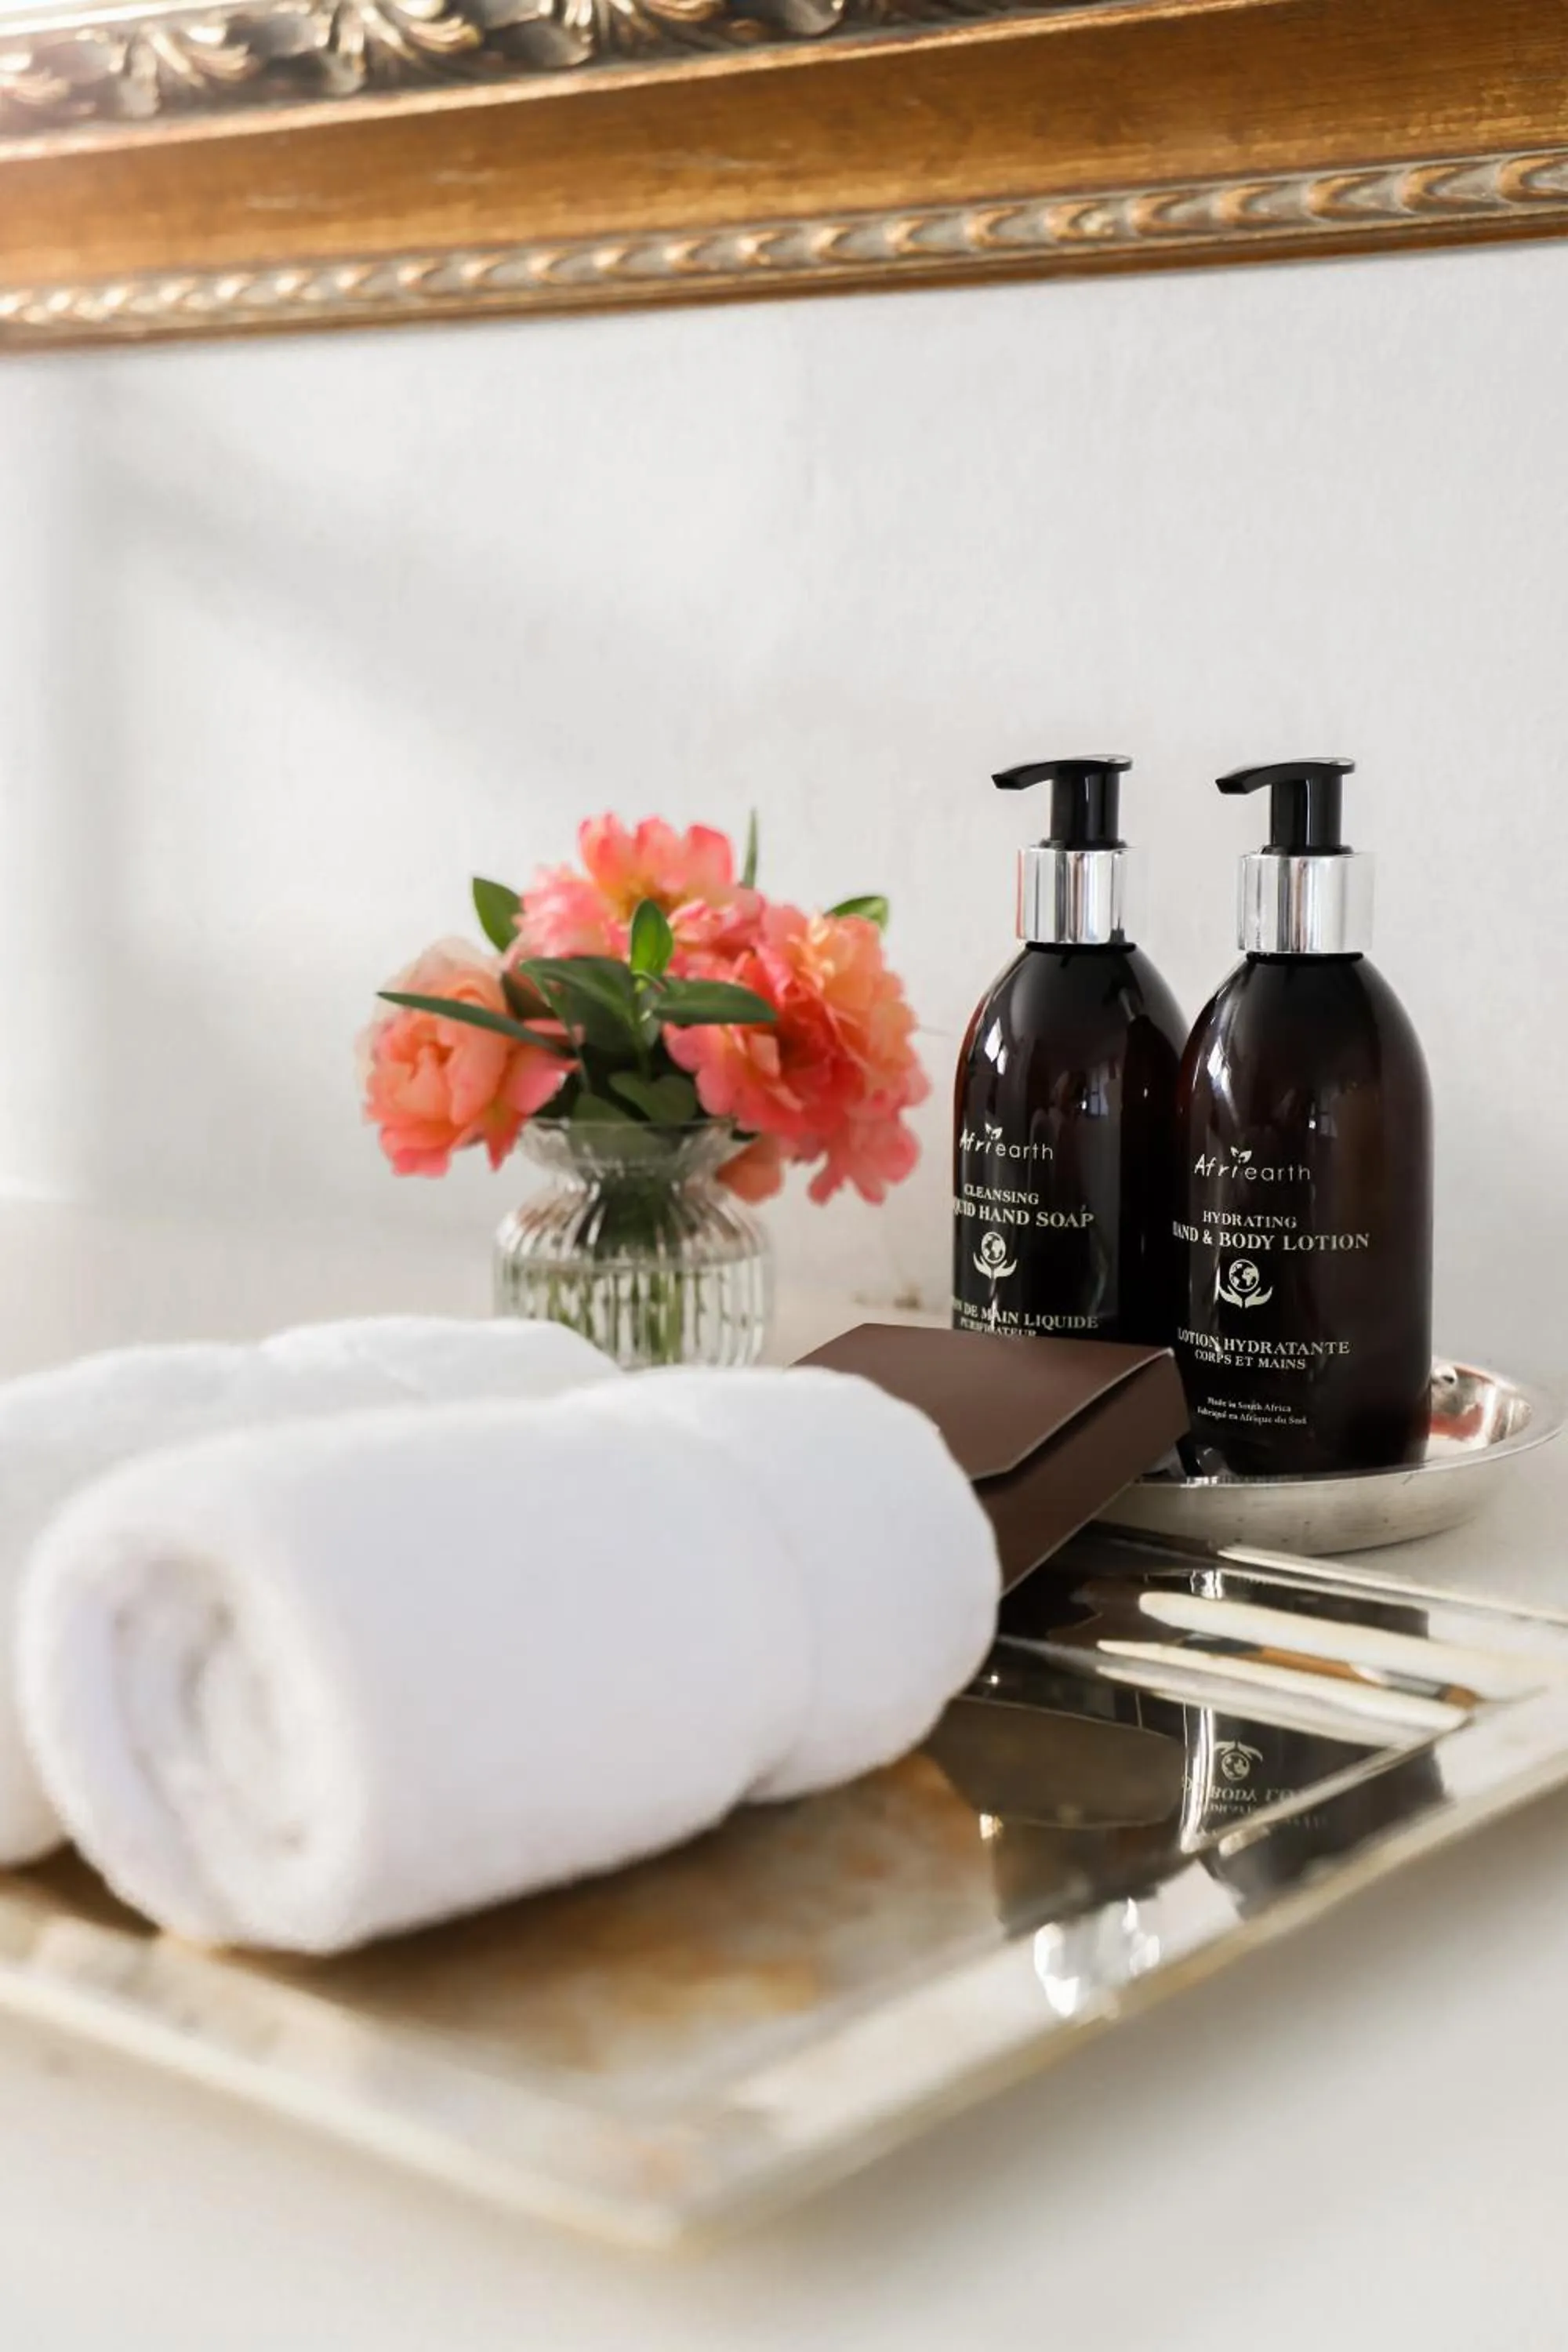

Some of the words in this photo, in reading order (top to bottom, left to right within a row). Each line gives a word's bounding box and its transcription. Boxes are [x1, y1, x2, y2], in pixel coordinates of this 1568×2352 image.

[964, 1184, 1040, 1205] CLEANSING
[978, 1205, 1030, 1225] HAND
[1036, 1211, 1094, 1228] SOAP
[1203, 1210, 1297, 1229] HYDRATING
[1202, 1229, 1213, 1245] &
[1219, 1232, 1275, 1250] BODY
[1283, 1232, 1370, 1250] LOTION
[964, 1302, 978, 1318] DE
[982, 1307, 1019, 1324] MAIN
[1024, 1313, 1098, 1330] LIQUIDE
[1177, 1328, 1218, 1348] LOTION
[1224, 1338, 1350, 1356] HYDRATANTE
[1195, 1348, 1232, 1366] CORPS
[1236, 1356, 1254, 1367] ET
[1258, 1358, 1305, 1370] MAINS
[1264, 1403, 1291, 1413] Africa
